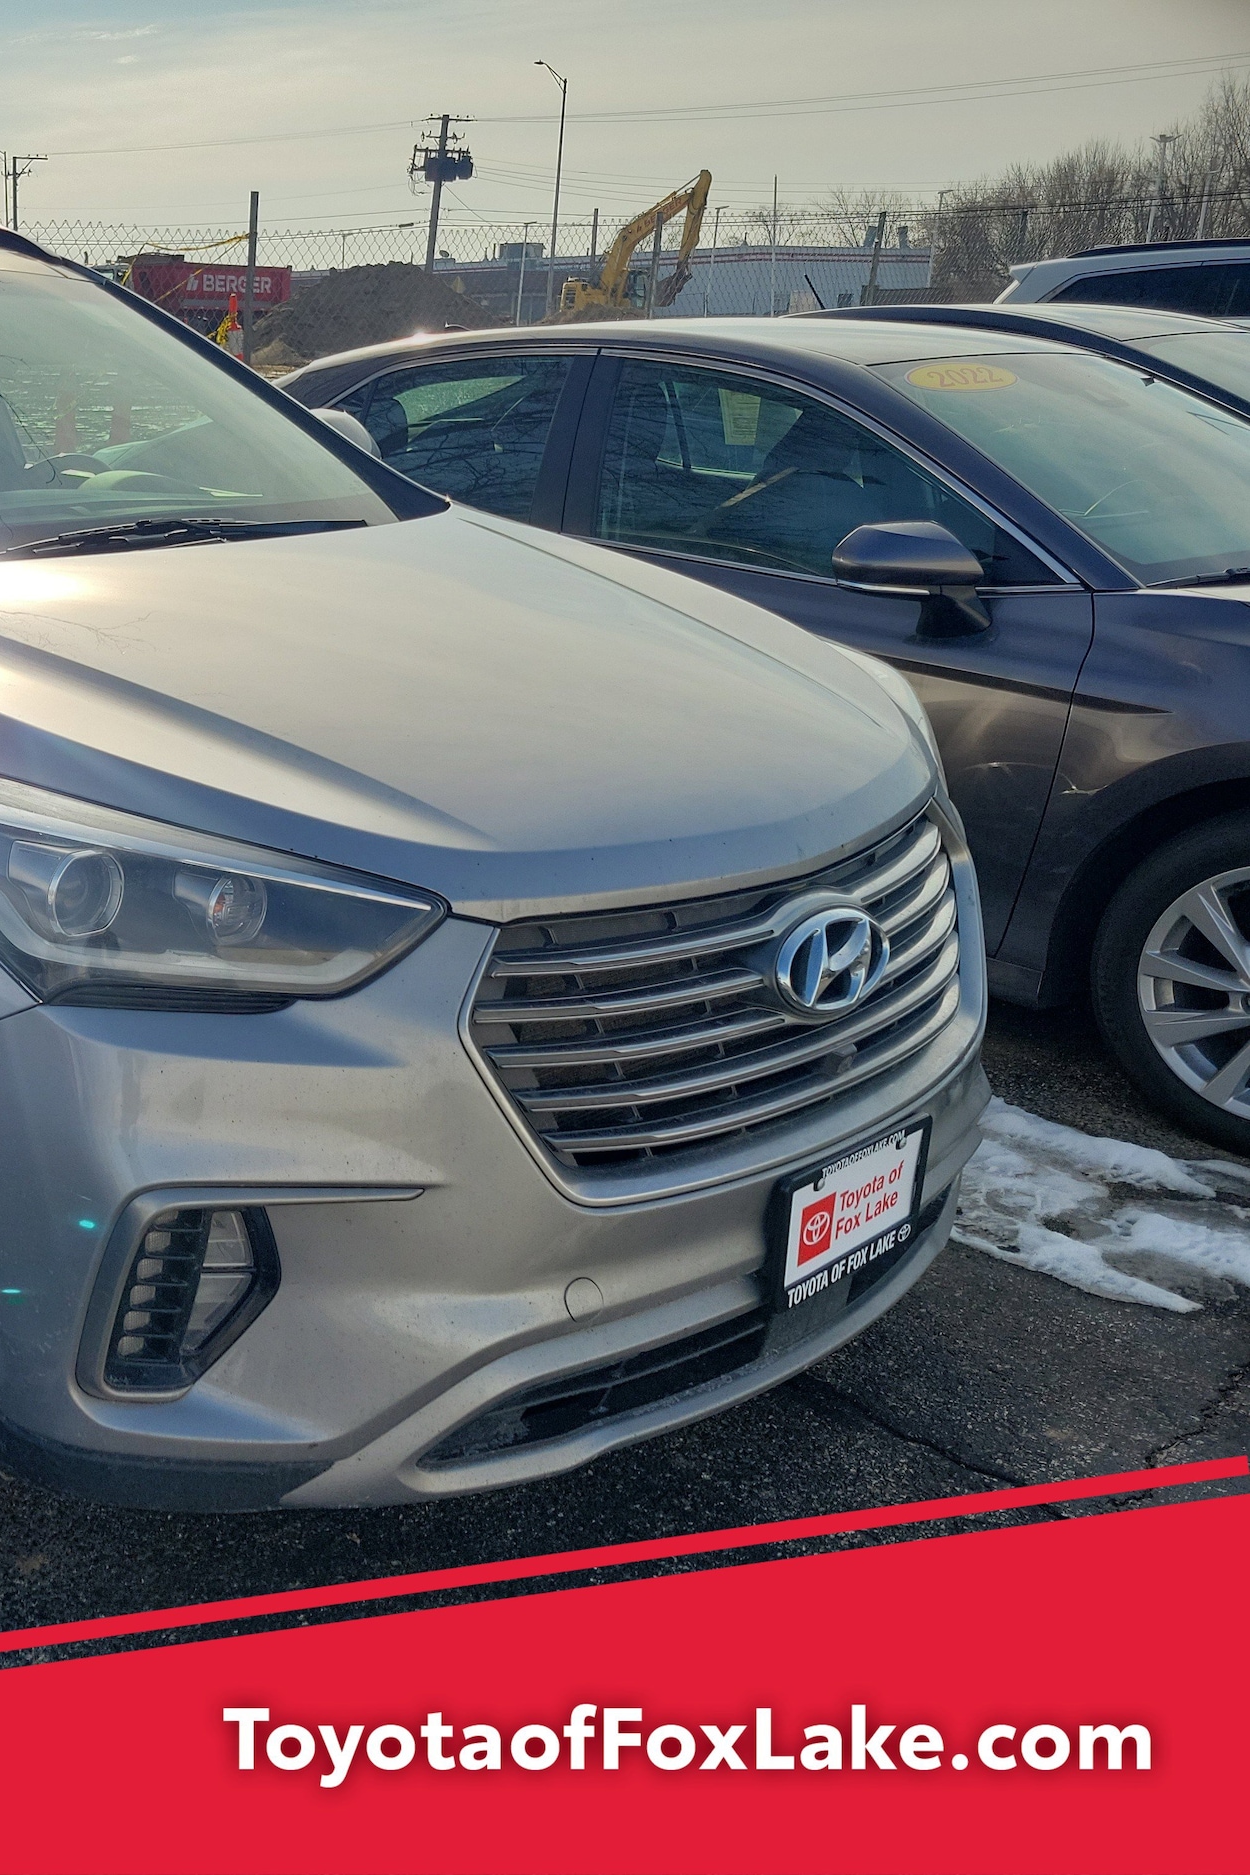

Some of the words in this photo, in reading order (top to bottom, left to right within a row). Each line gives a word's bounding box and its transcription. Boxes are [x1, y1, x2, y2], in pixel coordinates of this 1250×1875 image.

[203, 274, 272, 294] BERGER
[927, 367, 1003, 388] 2022
[840, 1175, 885, 1213] Toyota
[888, 1159, 905, 1185] of
[834, 1213, 861, 1241] Fox
[865, 1190, 899, 1223] Lake
[787, 1269, 829, 1309] TOYOTA
[831, 1258, 848, 1283] OF
[847, 1247, 869, 1275] FOX
[869, 1230, 897, 1263] LAKE
